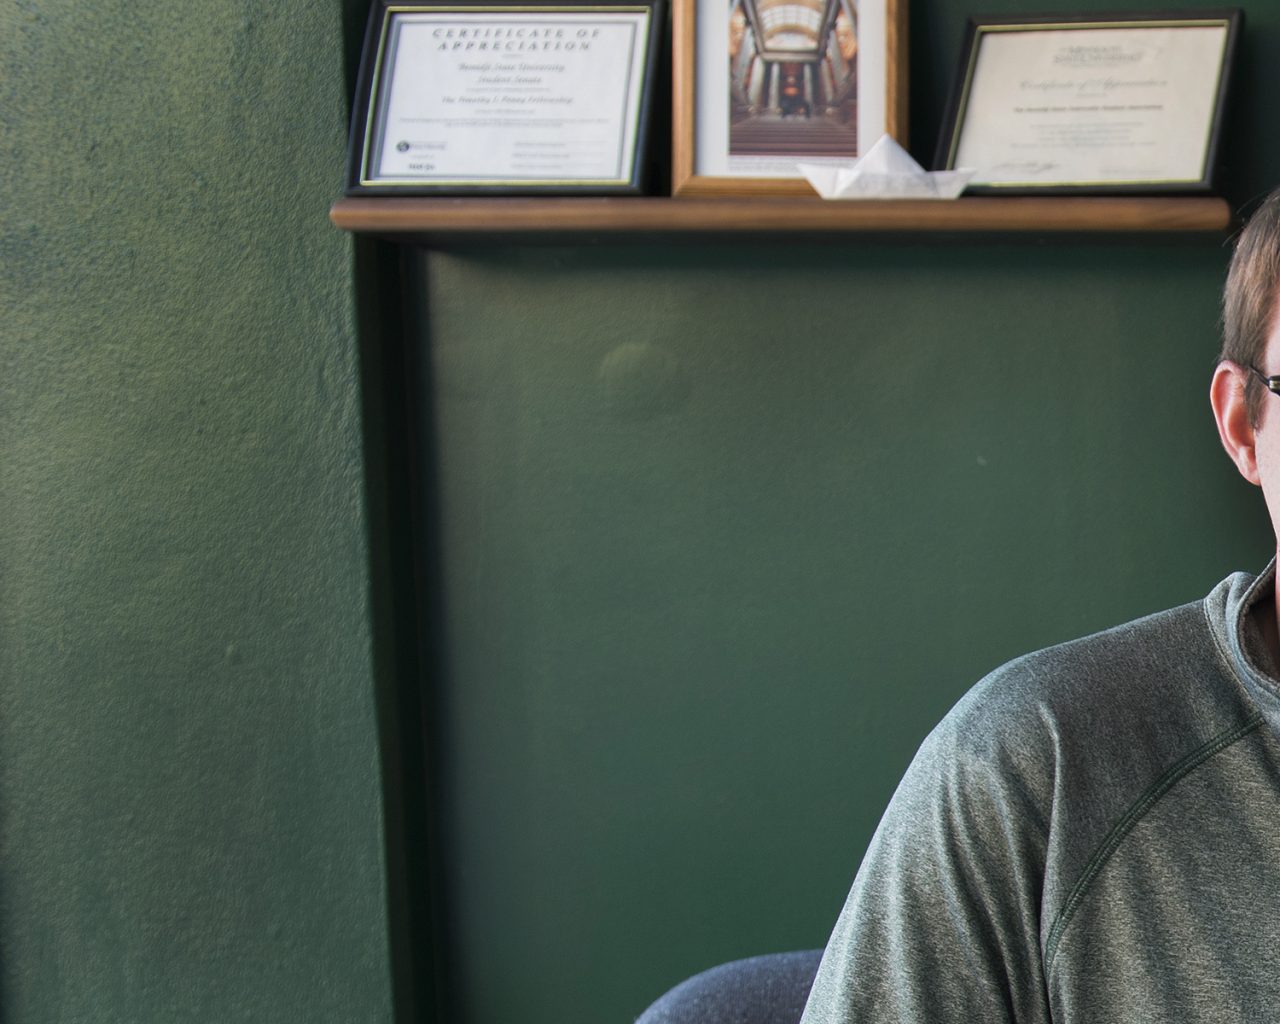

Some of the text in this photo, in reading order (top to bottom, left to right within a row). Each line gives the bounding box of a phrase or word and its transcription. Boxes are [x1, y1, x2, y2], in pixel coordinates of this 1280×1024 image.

[432, 28, 600, 39] CERTIFICATE OF
[438, 41, 591, 51] APPRECIATION
